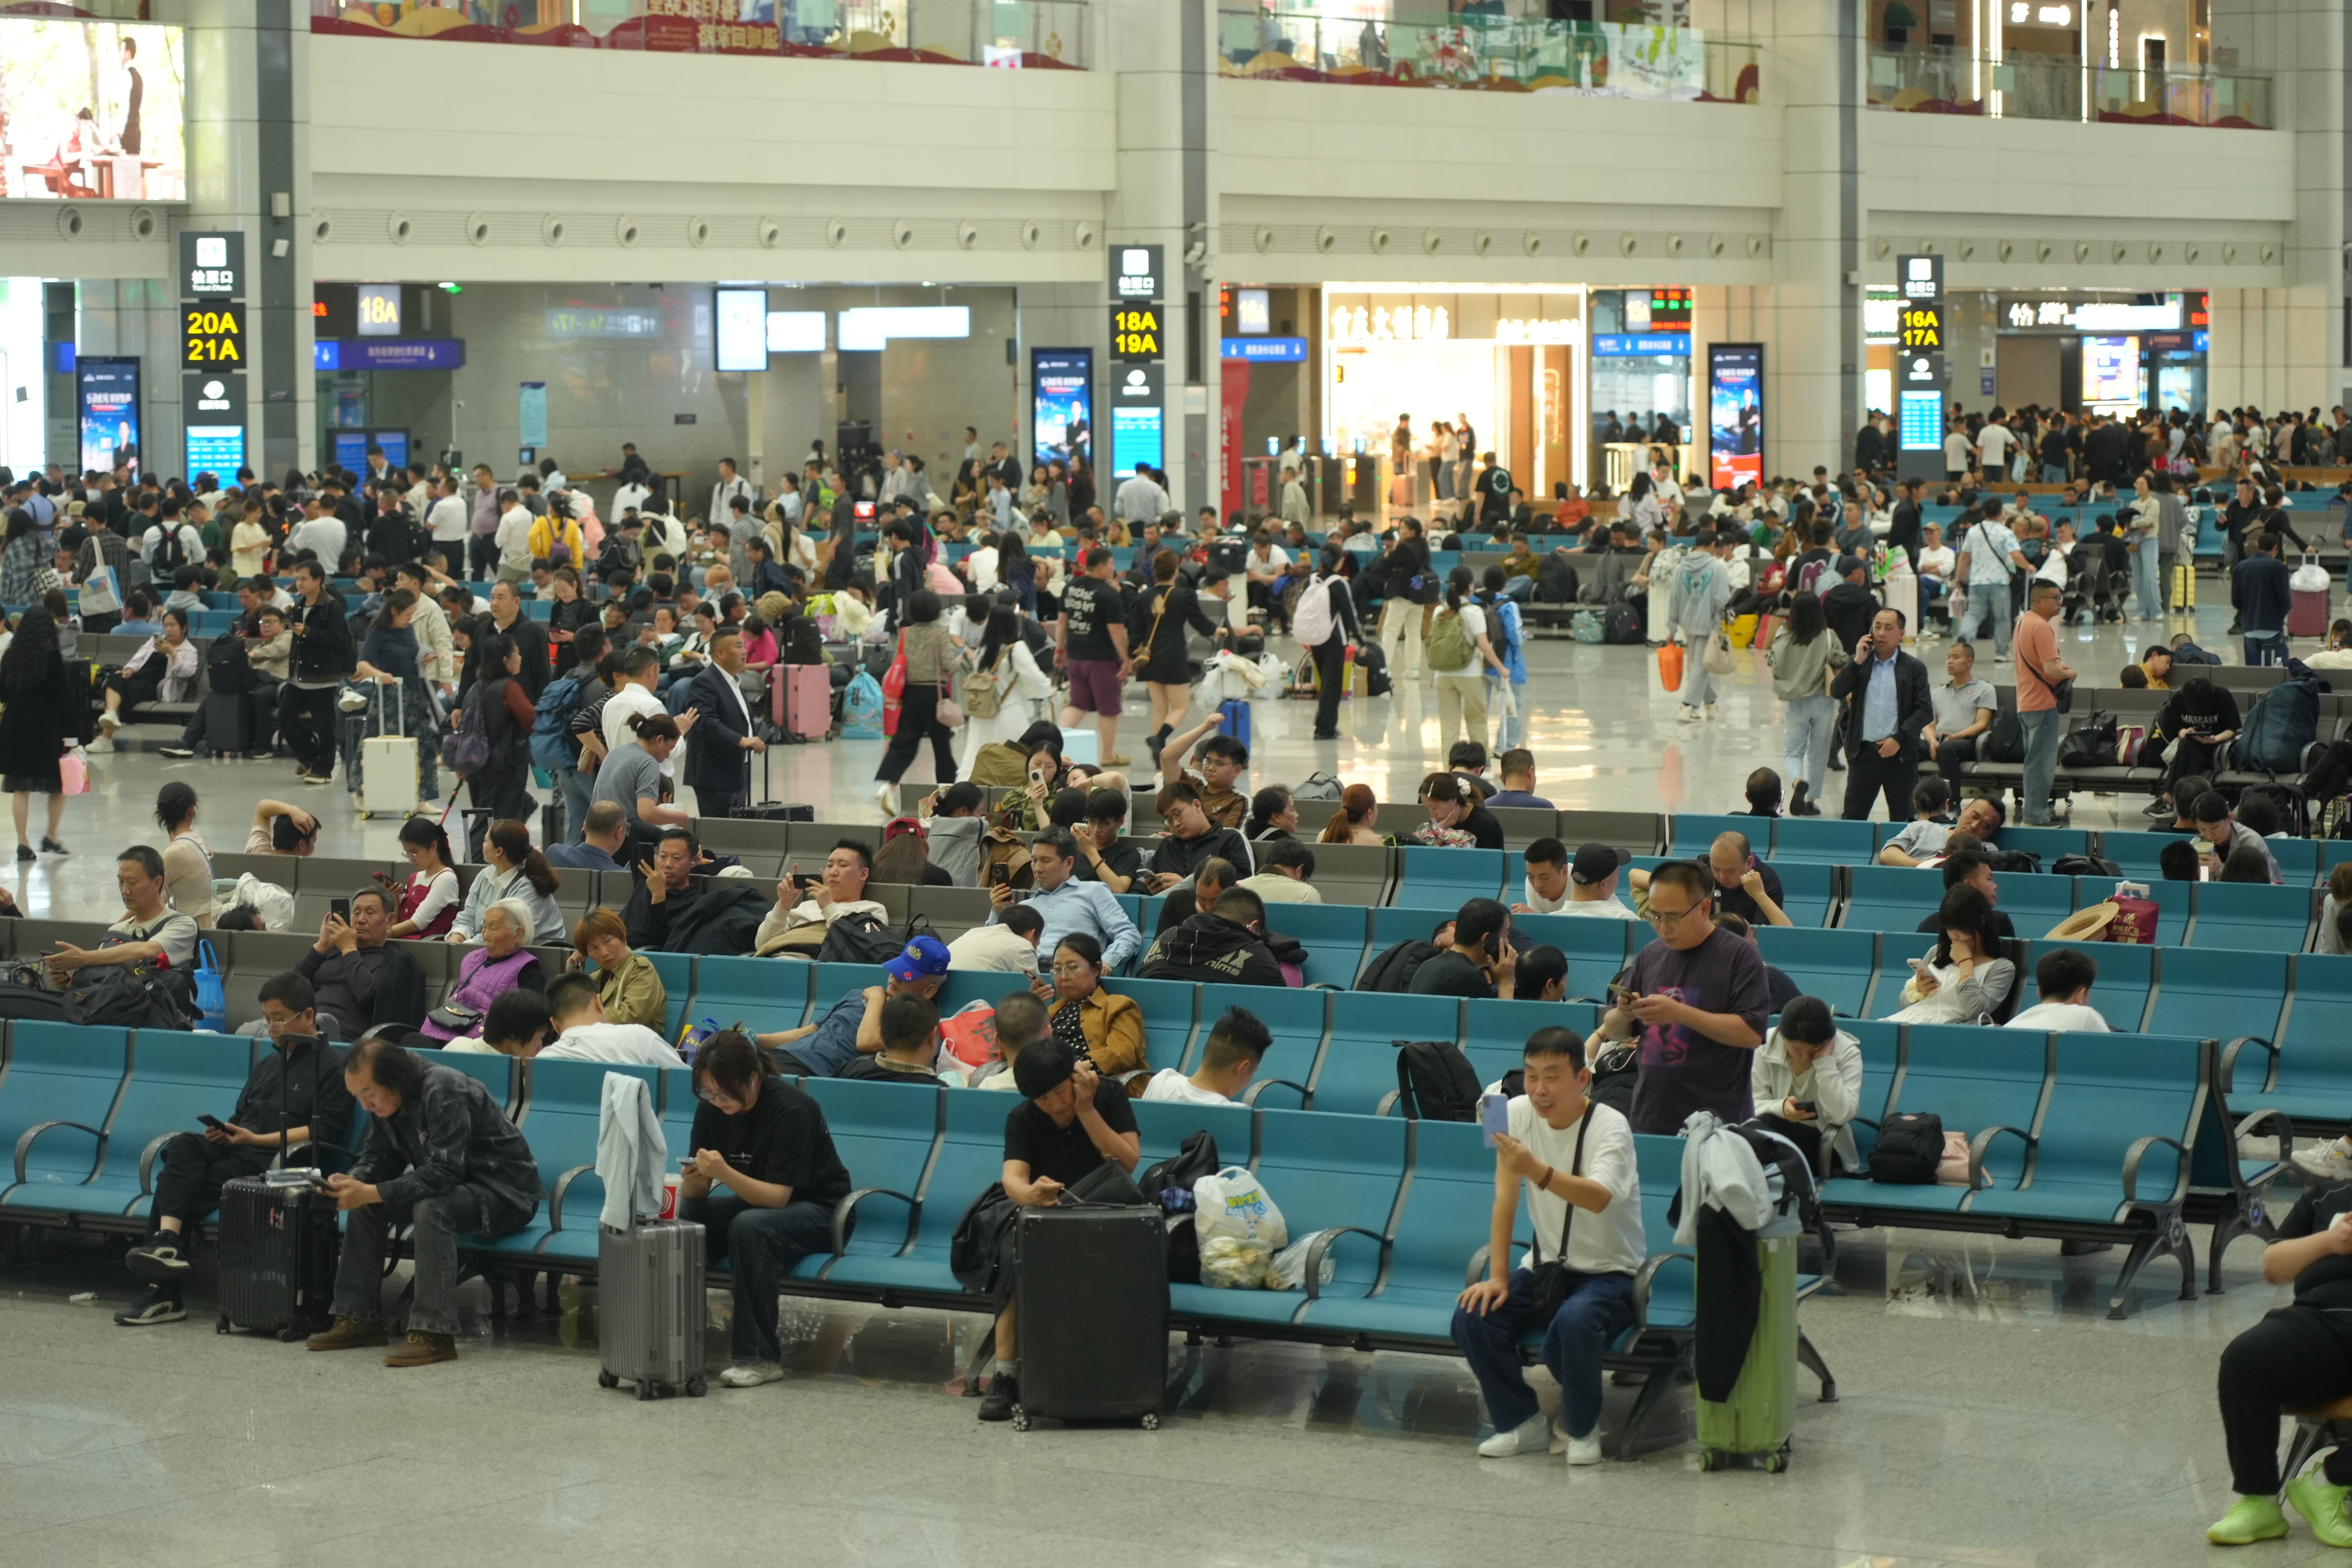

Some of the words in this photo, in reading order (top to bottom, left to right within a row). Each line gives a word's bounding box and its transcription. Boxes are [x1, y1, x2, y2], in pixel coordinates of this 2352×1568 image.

[191, 270, 233, 284] 检票口
[360, 296, 398, 324] 18A
[1903, 310, 1939, 328] 16A
[187, 312, 239, 334] 20A
[1115, 311, 1158, 331] 18A
[1115, 333, 1158, 353] 19A
[1903, 329, 1939, 346] 17A
[188, 338, 239, 360] 21A
